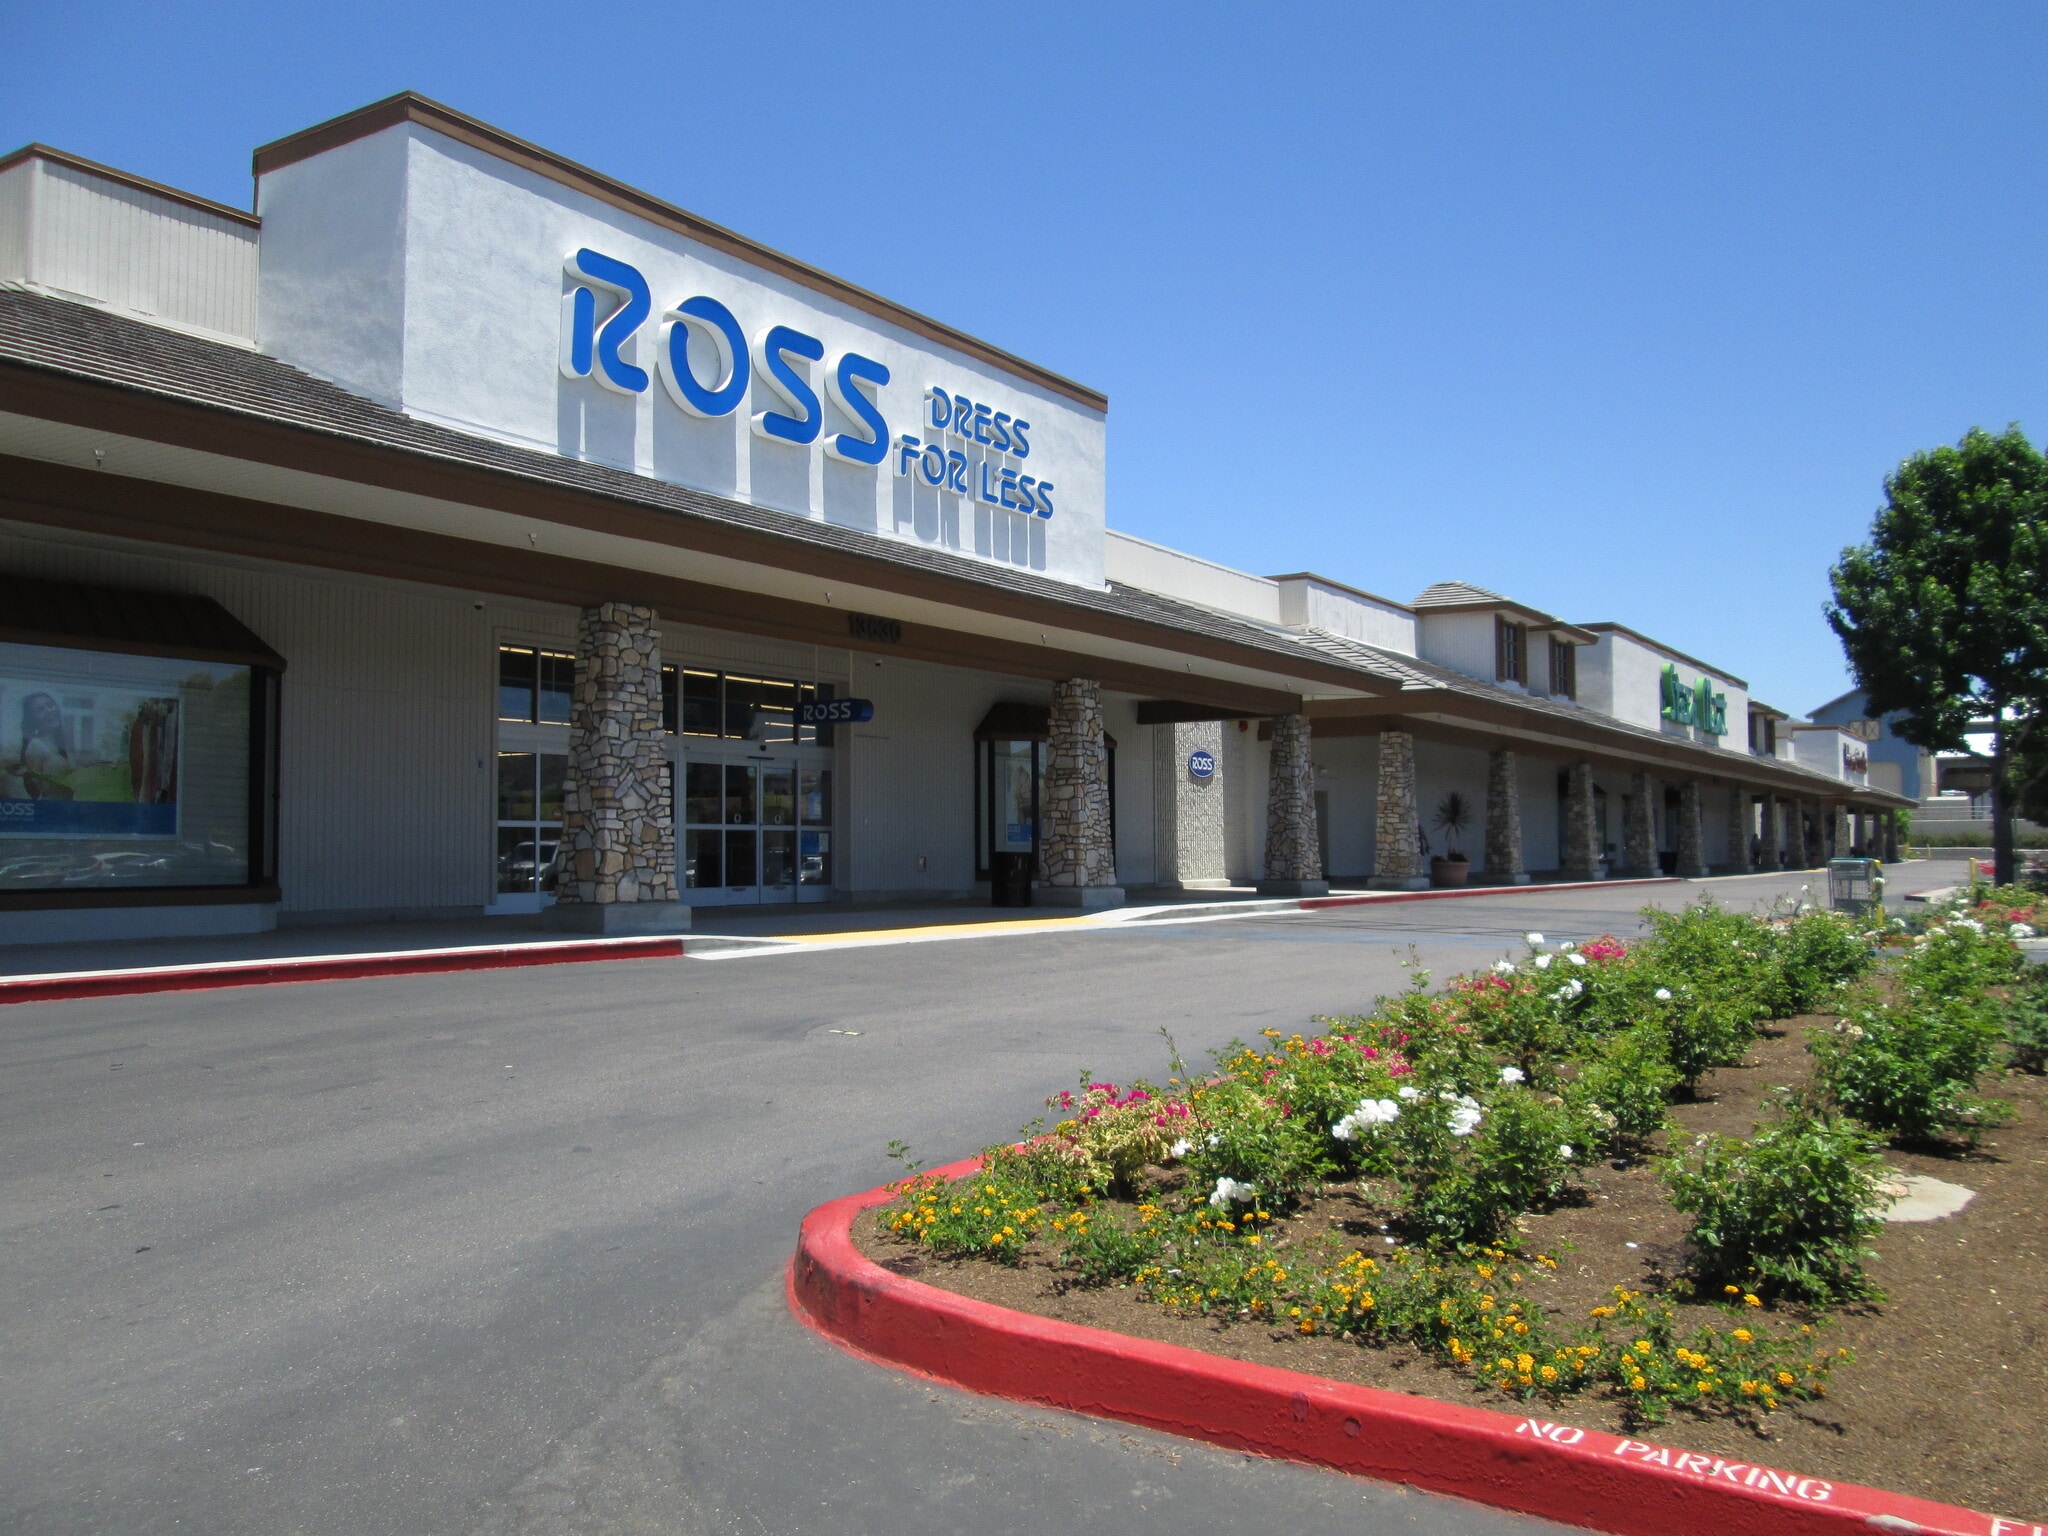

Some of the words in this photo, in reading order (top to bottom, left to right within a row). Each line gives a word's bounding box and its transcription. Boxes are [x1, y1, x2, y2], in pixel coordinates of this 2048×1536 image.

[562, 247, 890, 466] ROSS
[927, 385, 1031, 460] DRESS
[897, 434, 968, 494] FOR
[978, 460, 1054, 521] LESS
[803, 702, 852, 721] ROSS
[1192, 756, 1213, 771] ROSS
[0, 802, 36, 816] OSS
[1515, 1418, 1584, 1445] NO
[1613, 1439, 1835, 1502] PARKING
